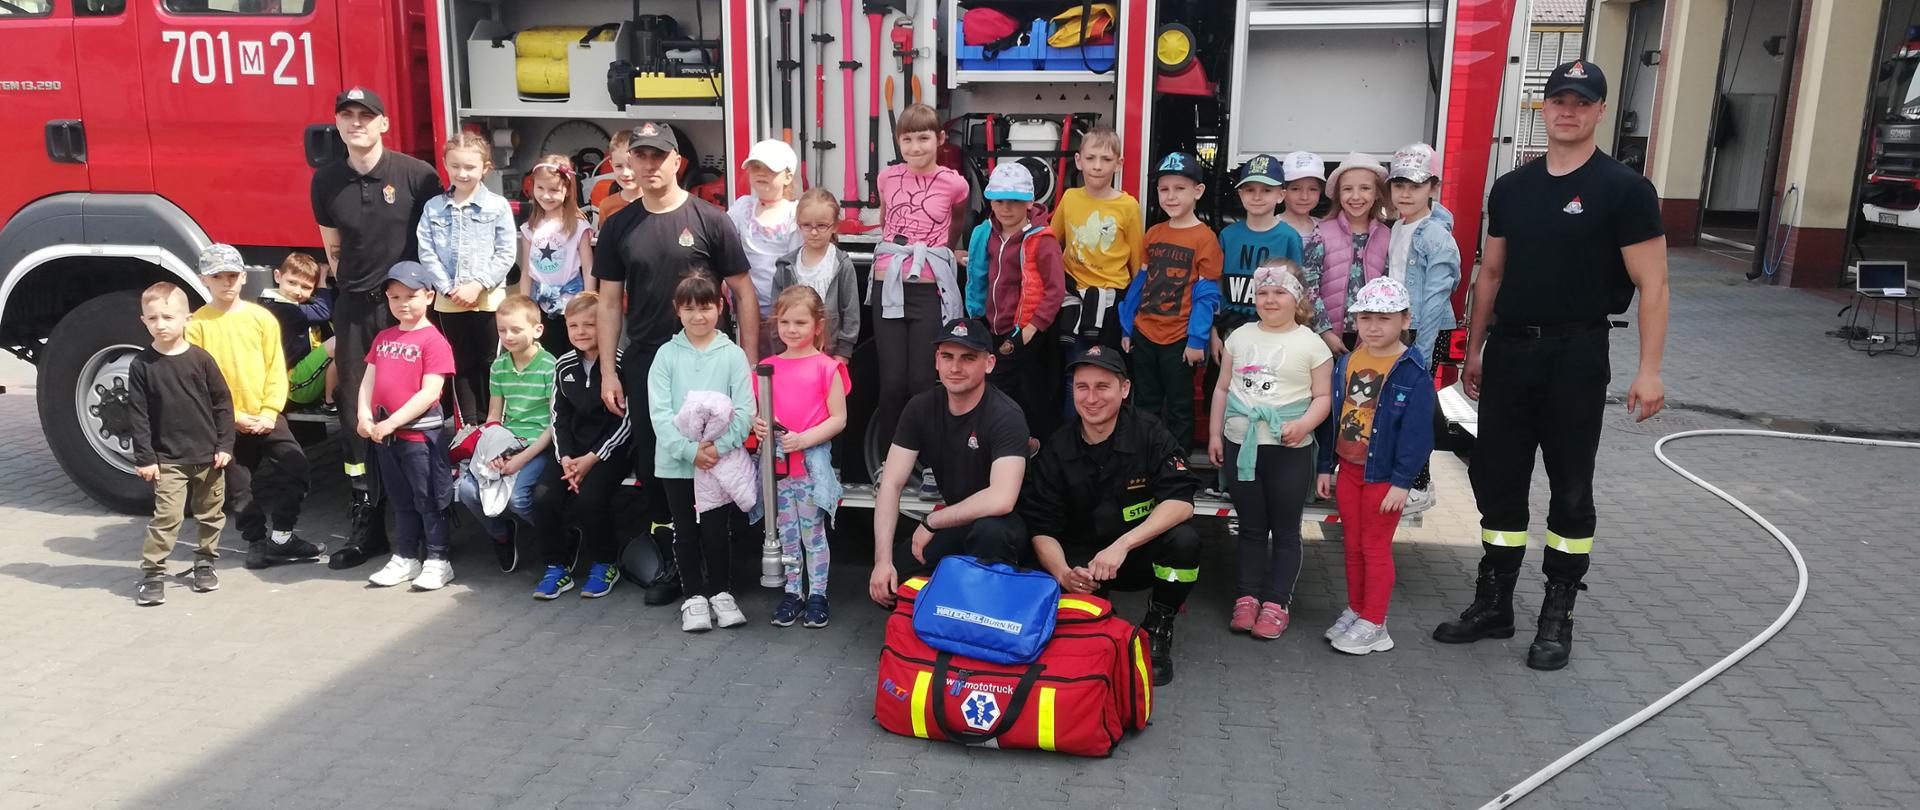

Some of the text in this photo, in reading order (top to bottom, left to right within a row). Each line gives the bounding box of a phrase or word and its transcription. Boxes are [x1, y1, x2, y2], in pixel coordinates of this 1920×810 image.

[162, 30, 315, 86] 701 M 21
[21, 80, 62, 91] 13.290
[1240, 244, 1270, 270] NO
[1229, 276, 1256, 304] WA
[1129, 502, 1155, 517] STRA
